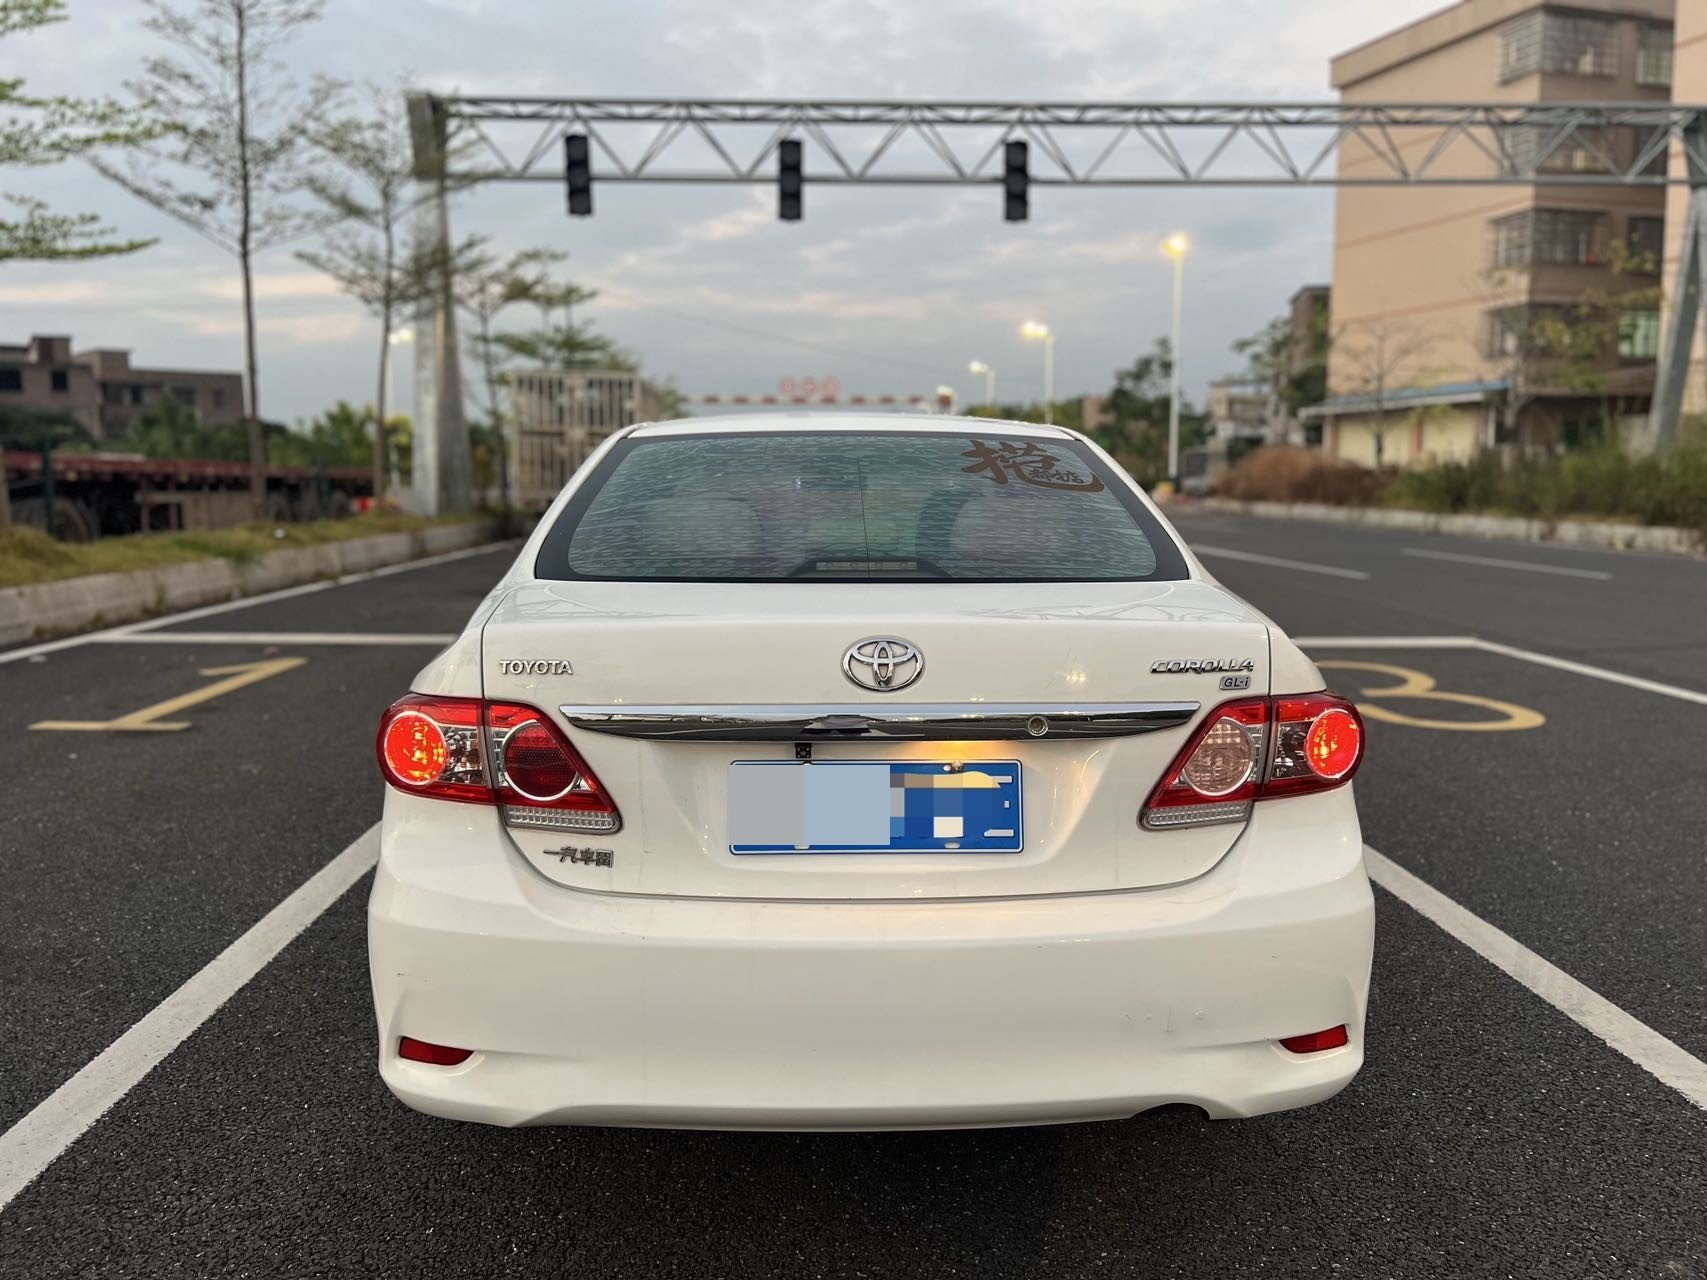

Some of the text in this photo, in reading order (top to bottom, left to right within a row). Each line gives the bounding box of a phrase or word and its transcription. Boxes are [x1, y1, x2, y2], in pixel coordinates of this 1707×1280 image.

[499, 660, 573, 675] TOYOTA
[1150, 658, 1255, 674] COROLLA
[1223, 677, 1250, 688] GL-i
[28, 657, 309, 731] 1
[1315, 660, 1546, 731] 3
